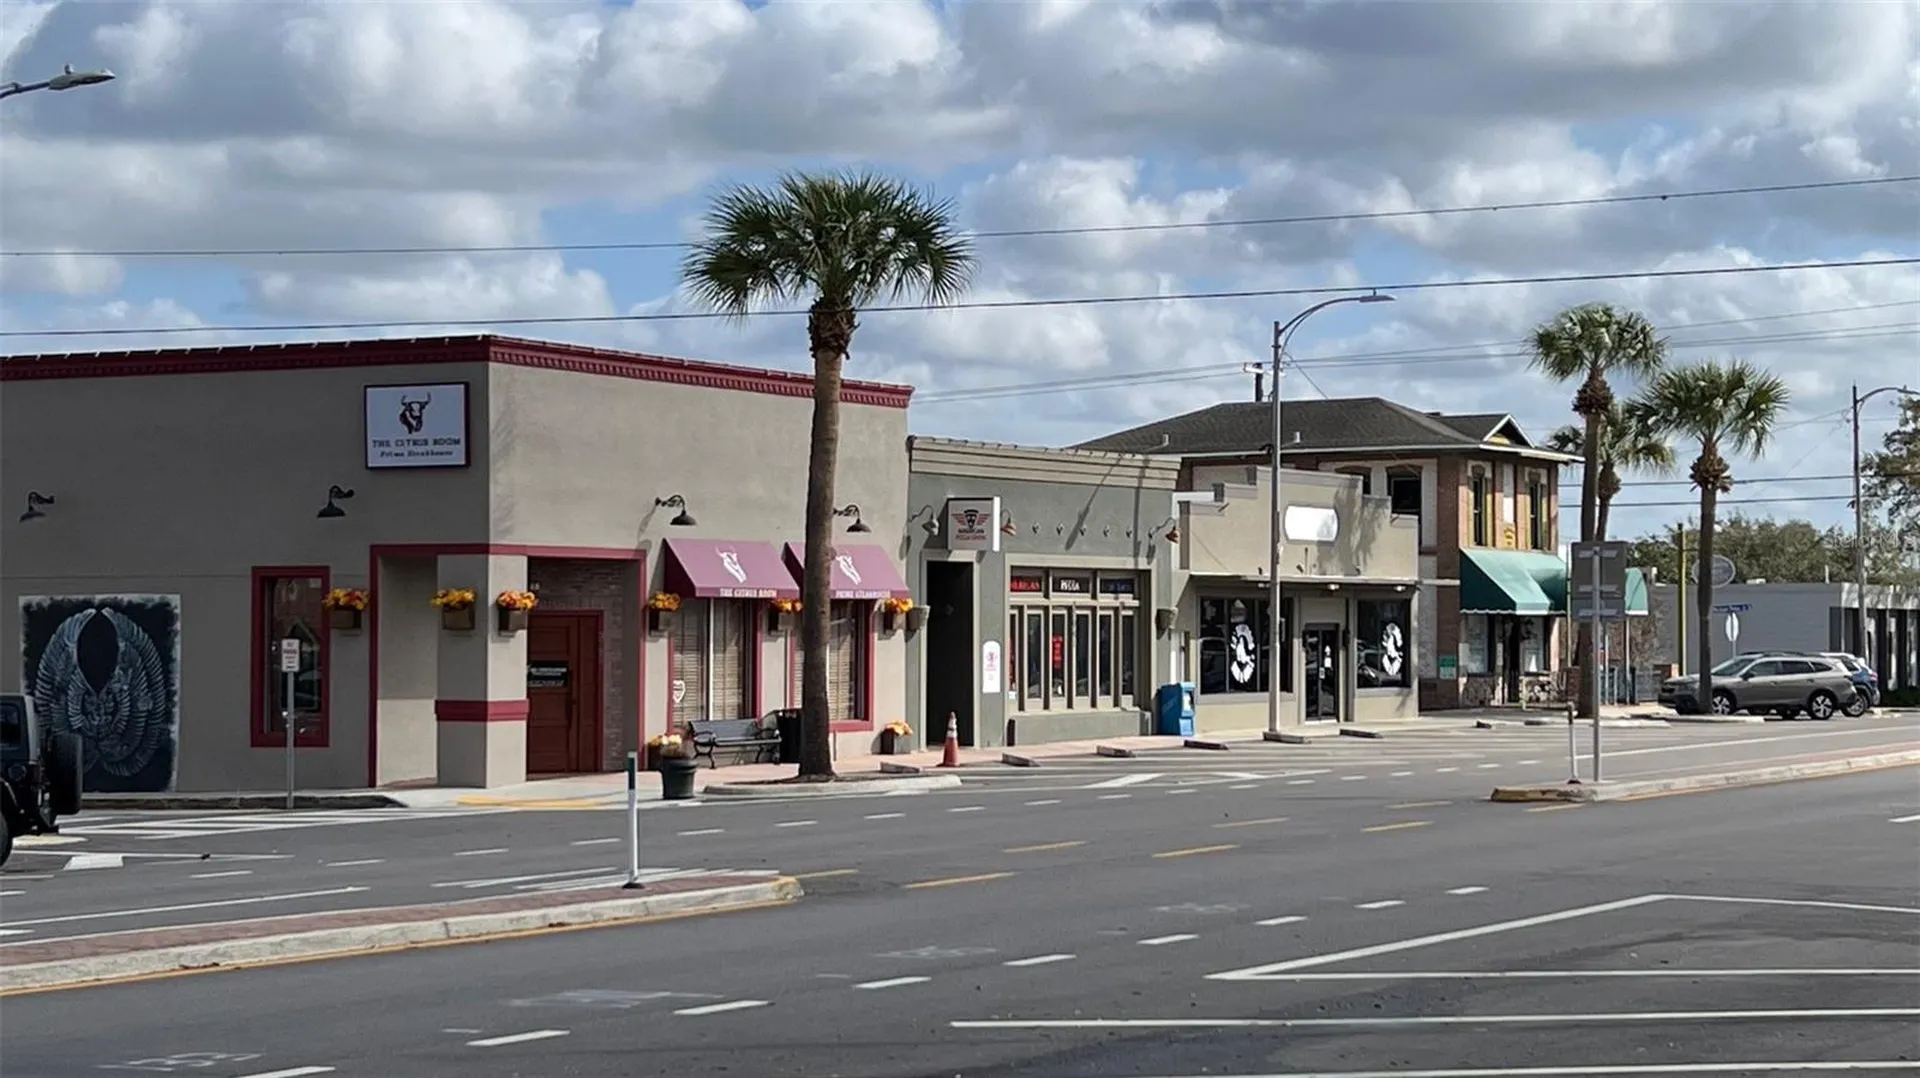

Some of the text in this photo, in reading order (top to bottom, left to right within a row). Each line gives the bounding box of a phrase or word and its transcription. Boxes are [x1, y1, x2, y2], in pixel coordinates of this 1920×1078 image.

[372, 438, 461, 448] THE CITRUS ROOM
